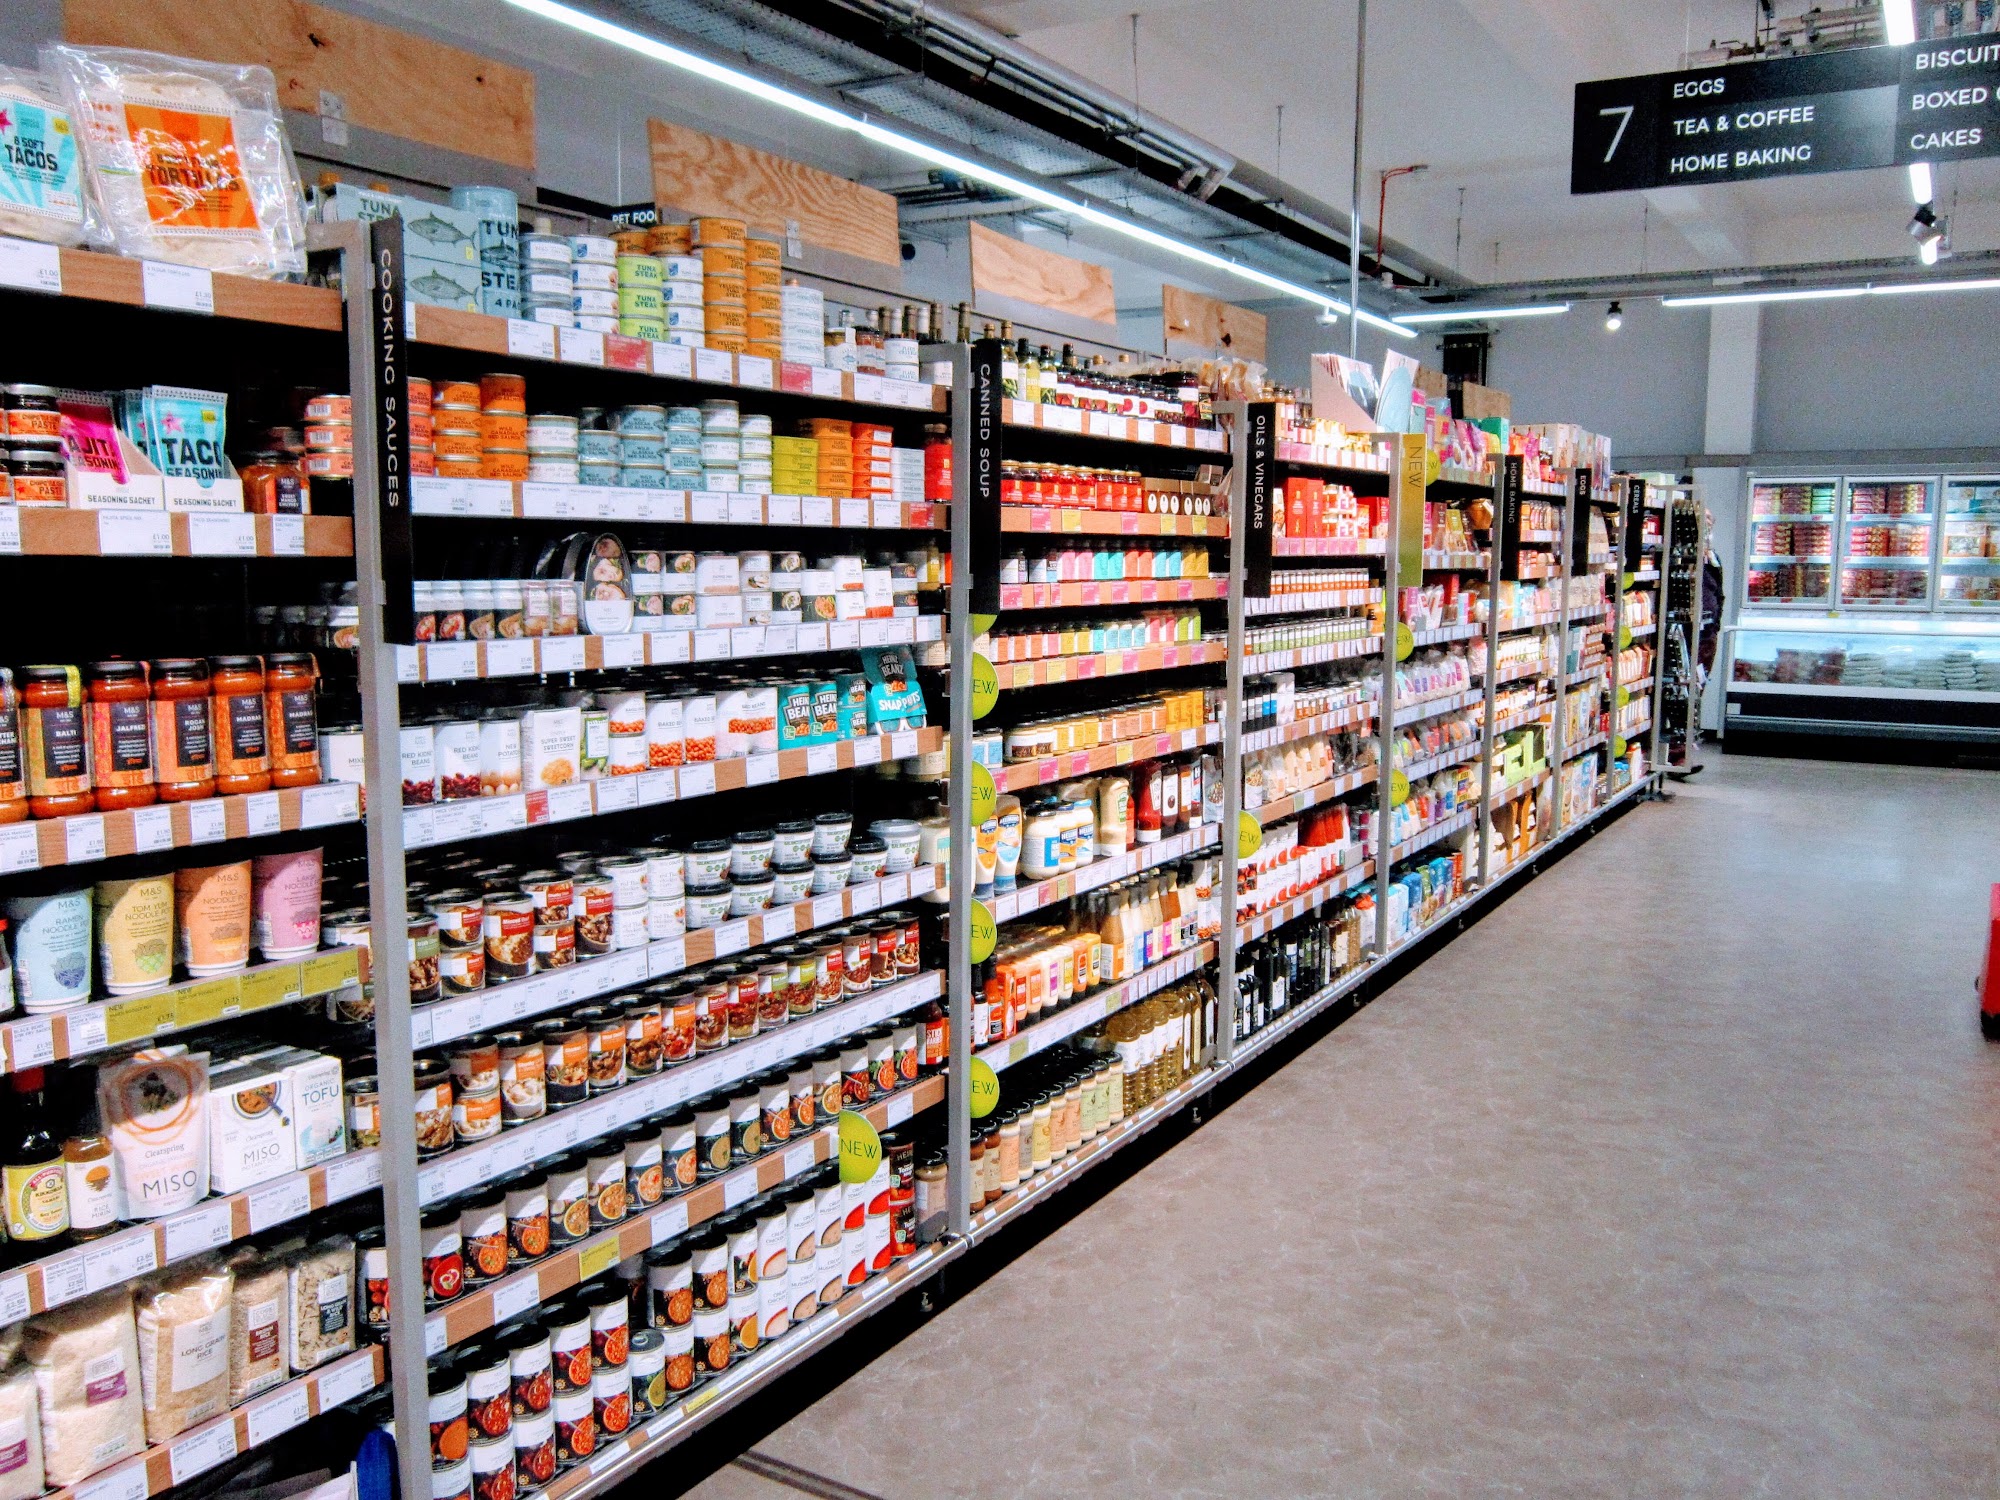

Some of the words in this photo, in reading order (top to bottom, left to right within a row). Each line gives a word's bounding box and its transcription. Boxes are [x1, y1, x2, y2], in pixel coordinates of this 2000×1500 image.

[1673, 77, 1726, 99] EGGS
[1912, 87, 1988, 110] BOXED
[1674, 117, 1709, 137] TEA
[1716, 115, 1730, 132] &
[1736, 106, 1815, 129] COFFEE
[1599, 105, 1635, 163] 7
[1910, 128, 1982, 150] CAKES
[21, 137, 45, 151] SOFT
[4, 143, 59, 172] TACOS
[1670, 152, 1728, 175] HOME
[1735, 144, 1812, 168] BAKING
[360, 198, 400, 216] TUNA
[612, 213, 630, 225] PET
[637, 294, 656, 302] TUNA
[381, 248, 396, 385] COOKING
[980, 363, 991, 441] CANNED
[1255, 415, 1266, 446] OILS
[385, 396, 399, 508] SAUCES
[1255, 450, 1265, 459] &
[979, 448, 990, 498] SOUP
[1409, 446, 1423, 488] NEW
[1509, 462, 1518, 488] HOME
[88, 494, 128, 504] SEASONING
[129, 496, 156, 505] SACHET
[174, 497, 211, 507] SEASONING
[213, 499, 237, 507] SACHET
[1253, 463, 1265, 529] VINEGARS
[1507, 491, 1517, 524] BAKING
[1396, 635, 1411, 646] EW
[882, 655, 899, 664] HEINZ
[881, 663, 904, 675] BEANZ
[973, 679, 996, 695] EW
[241, 698, 256, 706] M&S
[792, 696, 809, 707] HEIN
[819, 692, 837, 703] HEIN
[56, 711, 74, 719] M&S
[560, 735, 576, 743] SWEET
[543, 743, 574, 751] SWEETCORN
[1391, 780, 1408, 792] EW
[971, 786, 993, 801] EW
[1240, 832, 1259, 845] EW
[217, 873, 239, 883] M&S
[140, 887, 162, 896] M&S
[220, 889, 238, 897] PHO
[58, 899, 81, 909] M&S
[203, 895, 234, 905] NOODLE
[132, 905, 151, 913] TOM
[154, 902, 168, 911] YUM
[56, 915, 84, 925] RAMEN
[125, 911, 158, 921] NOODLE
[42, 924, 79, 934] NOODLE
[971, 925, 993, 940] EW
[304, 1078, 335, 1091] ORGANIC
[972, 1081, 995, 1096] EW
[301, 1084, 340, 1106] TOFU
[145, 1143, 185, 1159] Clearspring
[243, 1142, 281, 1165] MISO
[840, 1139, 878, 1159] NEW
[143, 1170, 198, 1199] MISO
[181, 1345, 203, 1357] LONG
[197, 1348, 213, 1359] RICE
